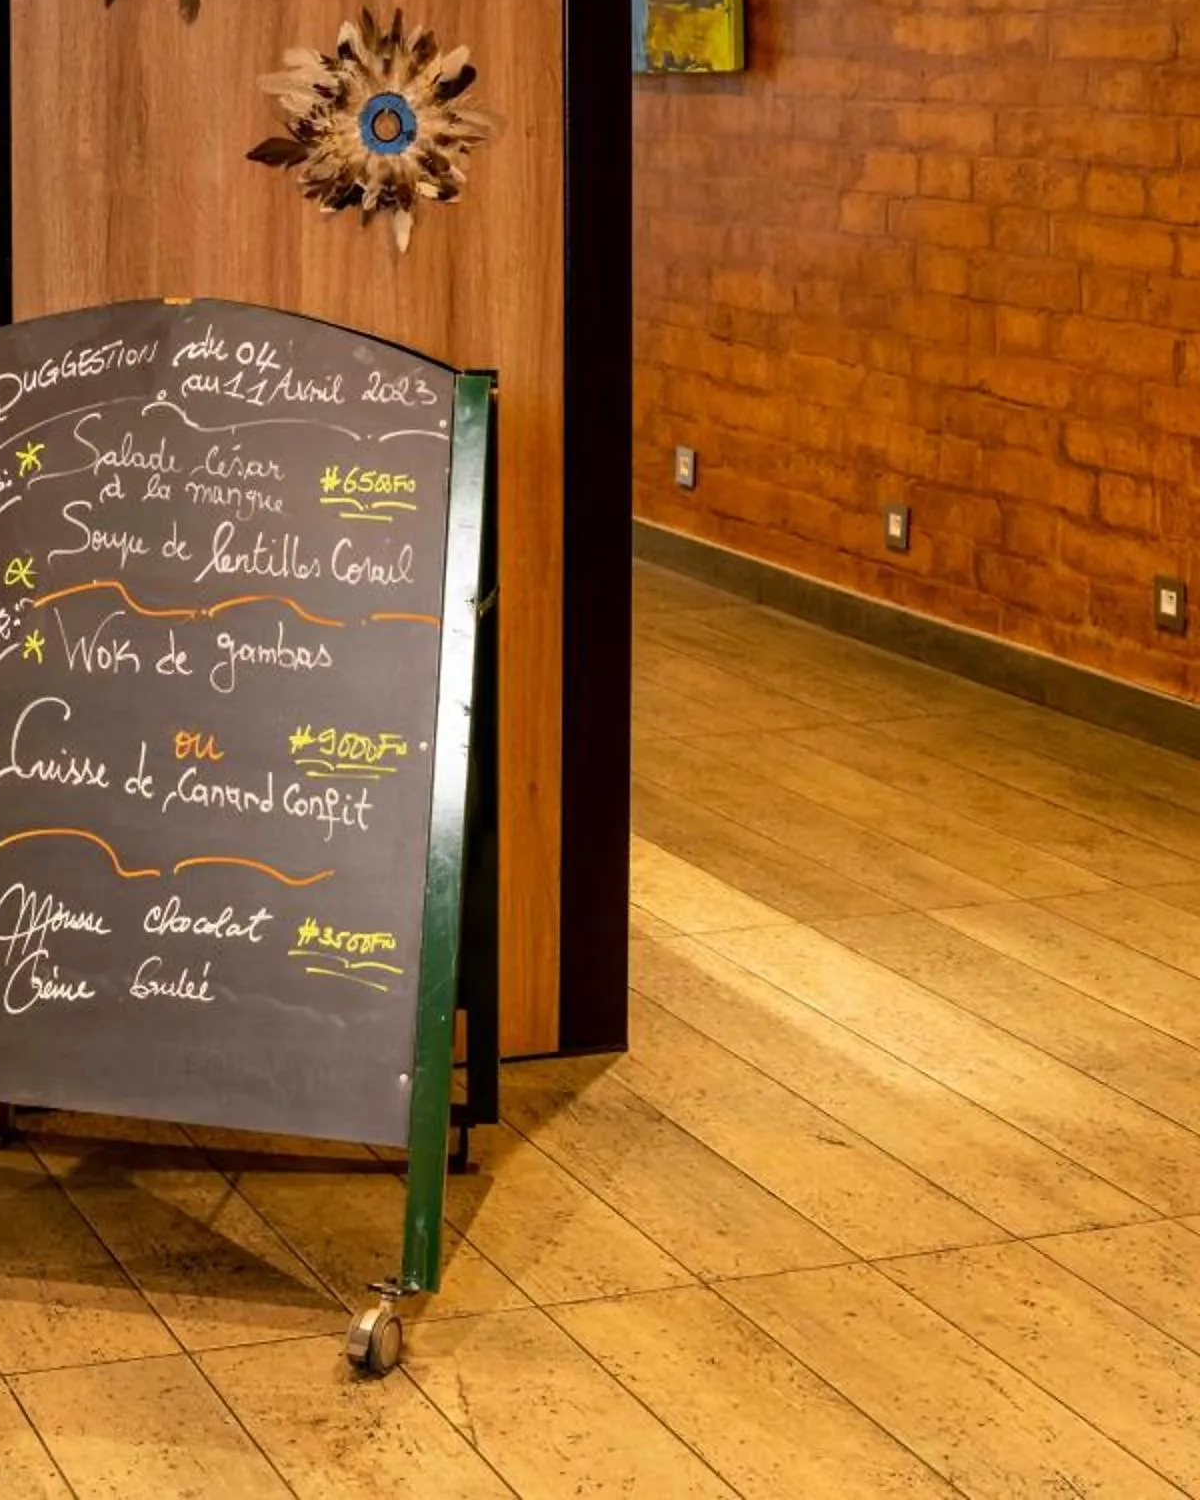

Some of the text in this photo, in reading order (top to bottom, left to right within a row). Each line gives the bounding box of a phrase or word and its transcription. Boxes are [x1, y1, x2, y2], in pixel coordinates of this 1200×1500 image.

[234, 339, 282, 374] 04
[360, 369, 439, 406] 2023
[27, 412, 184, 488] Salade
[141, 472, 174, 502] la
[46, 499, 152, 570] Soupe
[161, 519, 193, 561] de
[155, 628, 193, 676] de
[209, 620, 334, 694] gambas
[124, 740, 154, 799] de
